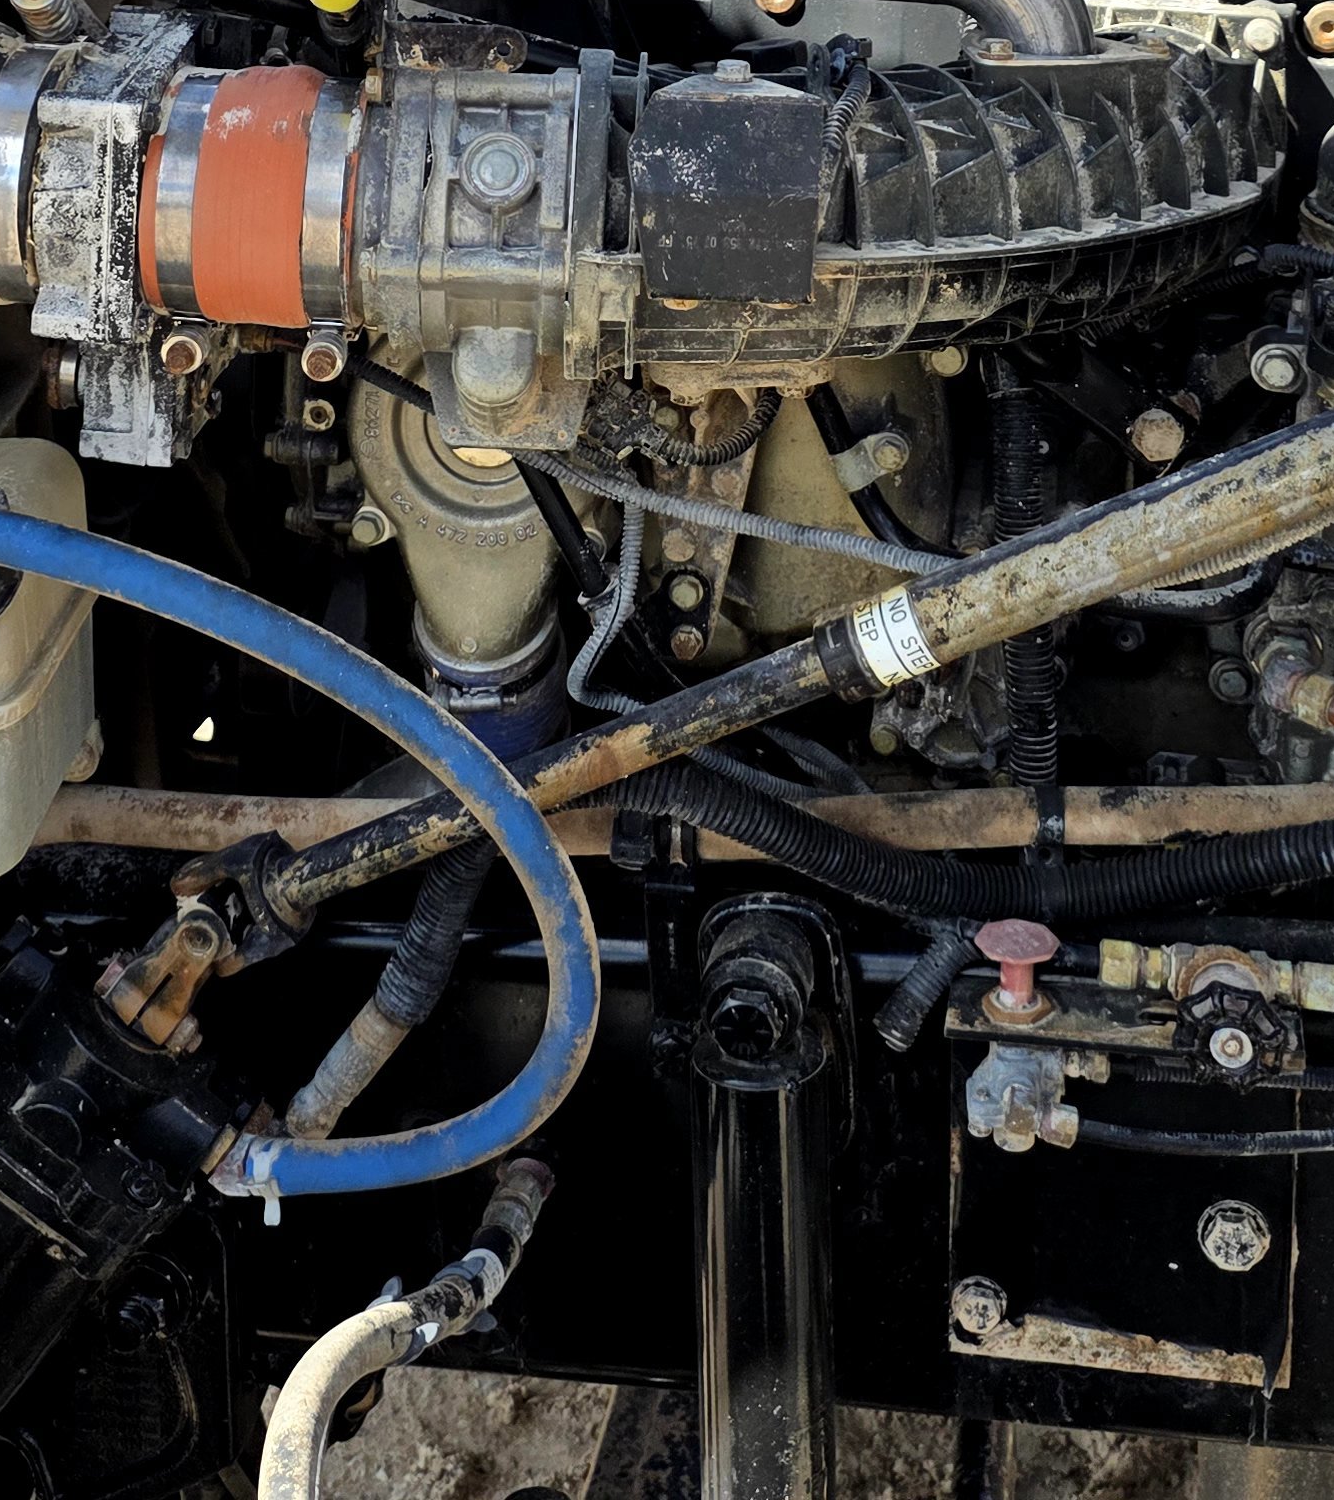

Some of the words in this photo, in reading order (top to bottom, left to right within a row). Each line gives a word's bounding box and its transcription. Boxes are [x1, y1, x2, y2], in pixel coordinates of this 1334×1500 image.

[436, 523, 468, 544] 472
[476, 532, 508, 547] 200
[516, 522, 539, 542] 02
[857, 601, 880, 642] STEP
[883, 671, 903, 683] N
[887, 596, 908, 624] NO
[900, 636, 935, 670] STEP
